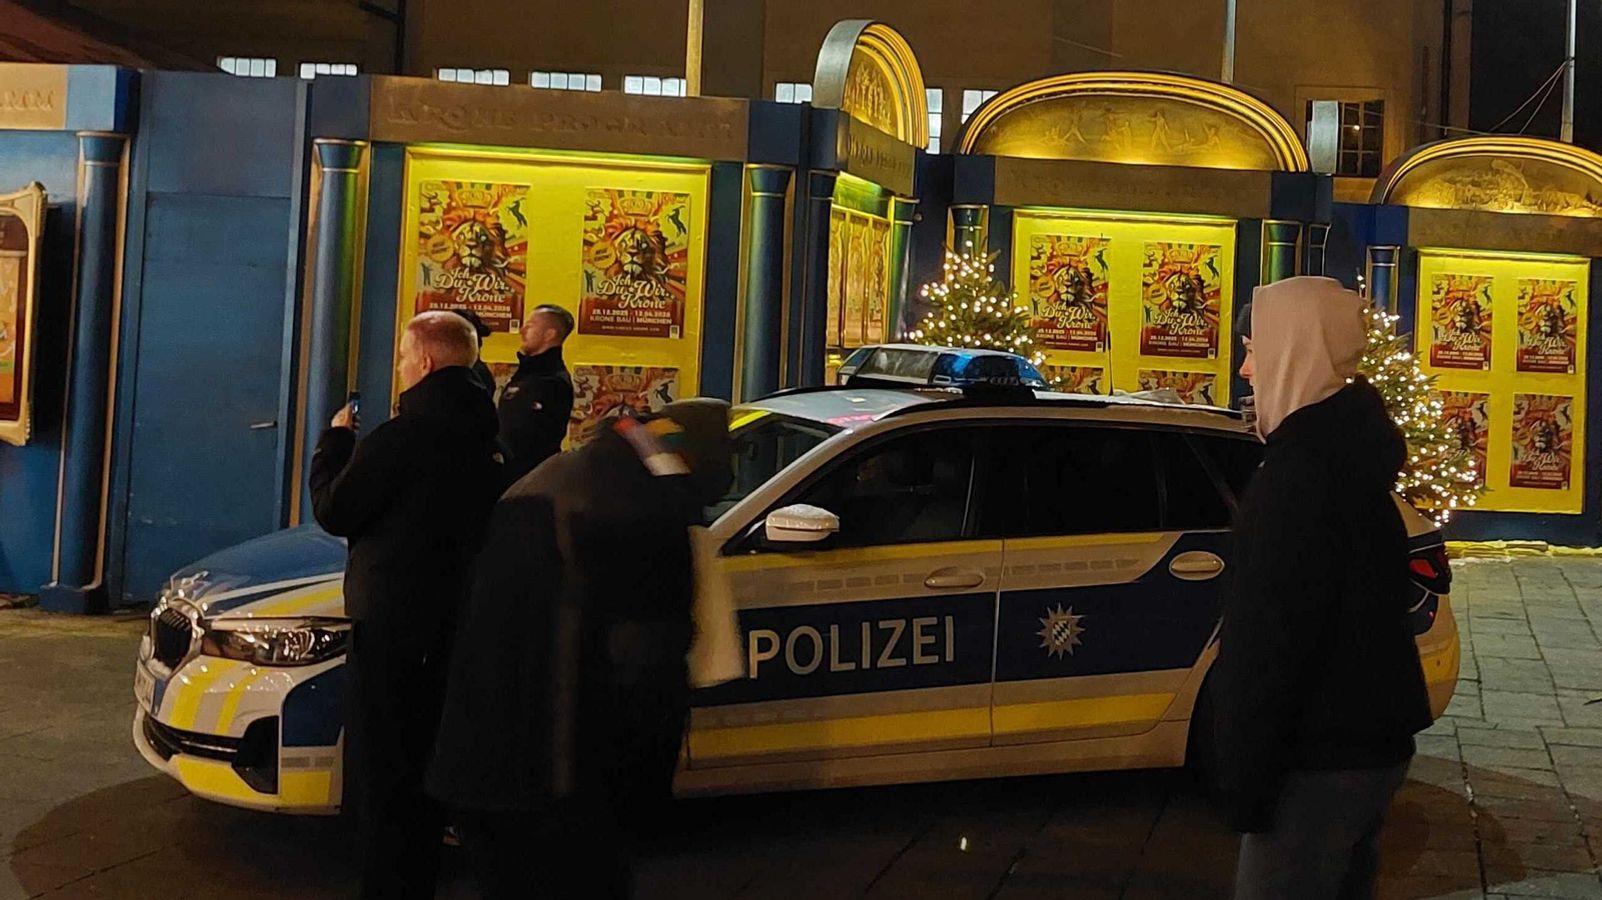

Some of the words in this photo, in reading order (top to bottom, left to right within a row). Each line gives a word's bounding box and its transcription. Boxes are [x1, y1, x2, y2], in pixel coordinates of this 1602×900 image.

[456, 287, 506, 303] Krone
[618, 293, 666, 309] Krone
[749, 616, 954, 679] POLIZEI
